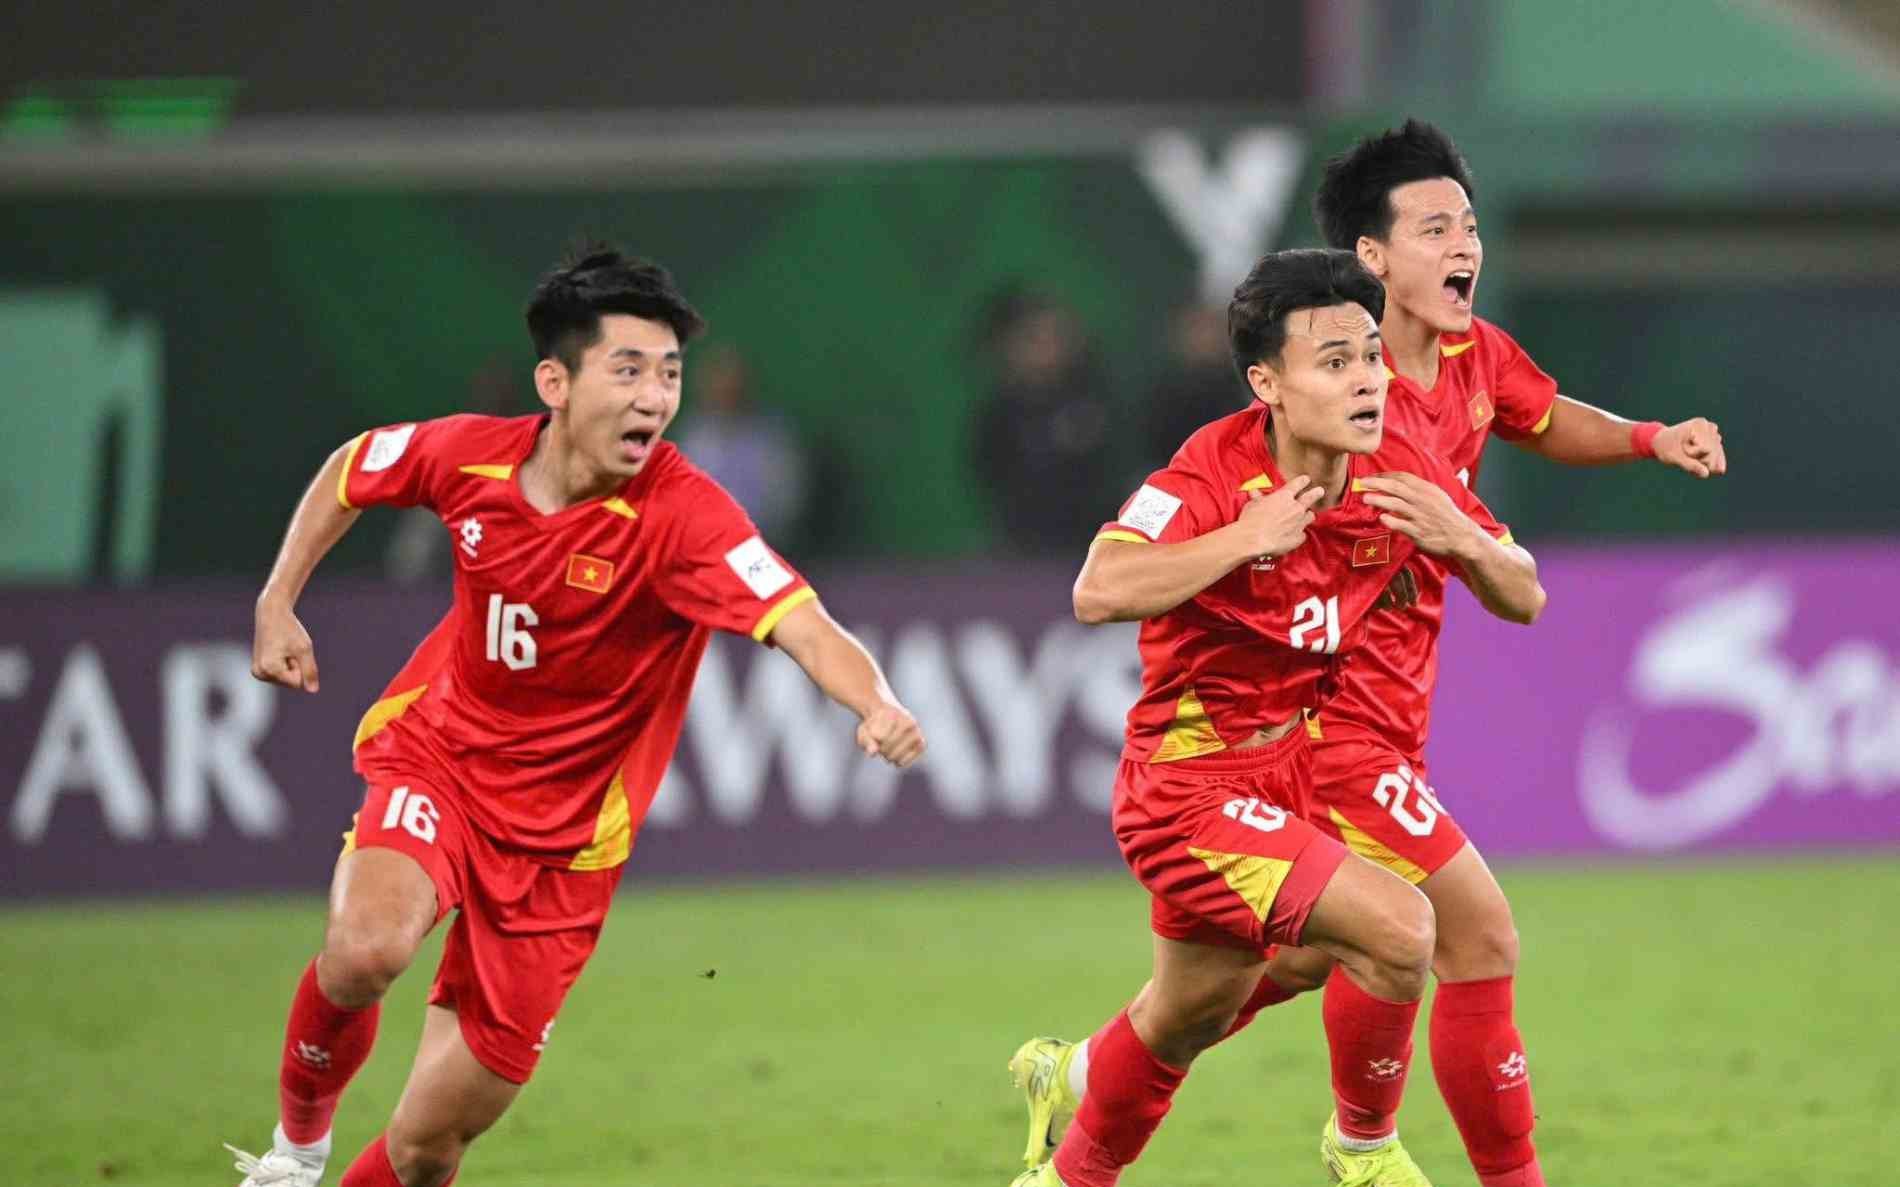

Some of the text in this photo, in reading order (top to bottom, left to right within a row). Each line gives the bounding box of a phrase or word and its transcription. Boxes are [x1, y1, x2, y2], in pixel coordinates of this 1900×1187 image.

[486, 593, 539, 671] 16
[1289, 594, 1341, 655] 21
[645, 618, 1143, 826] WAYS
[382, 786, 441, 846] 16
[1222, 797, 1295, 832] 2
